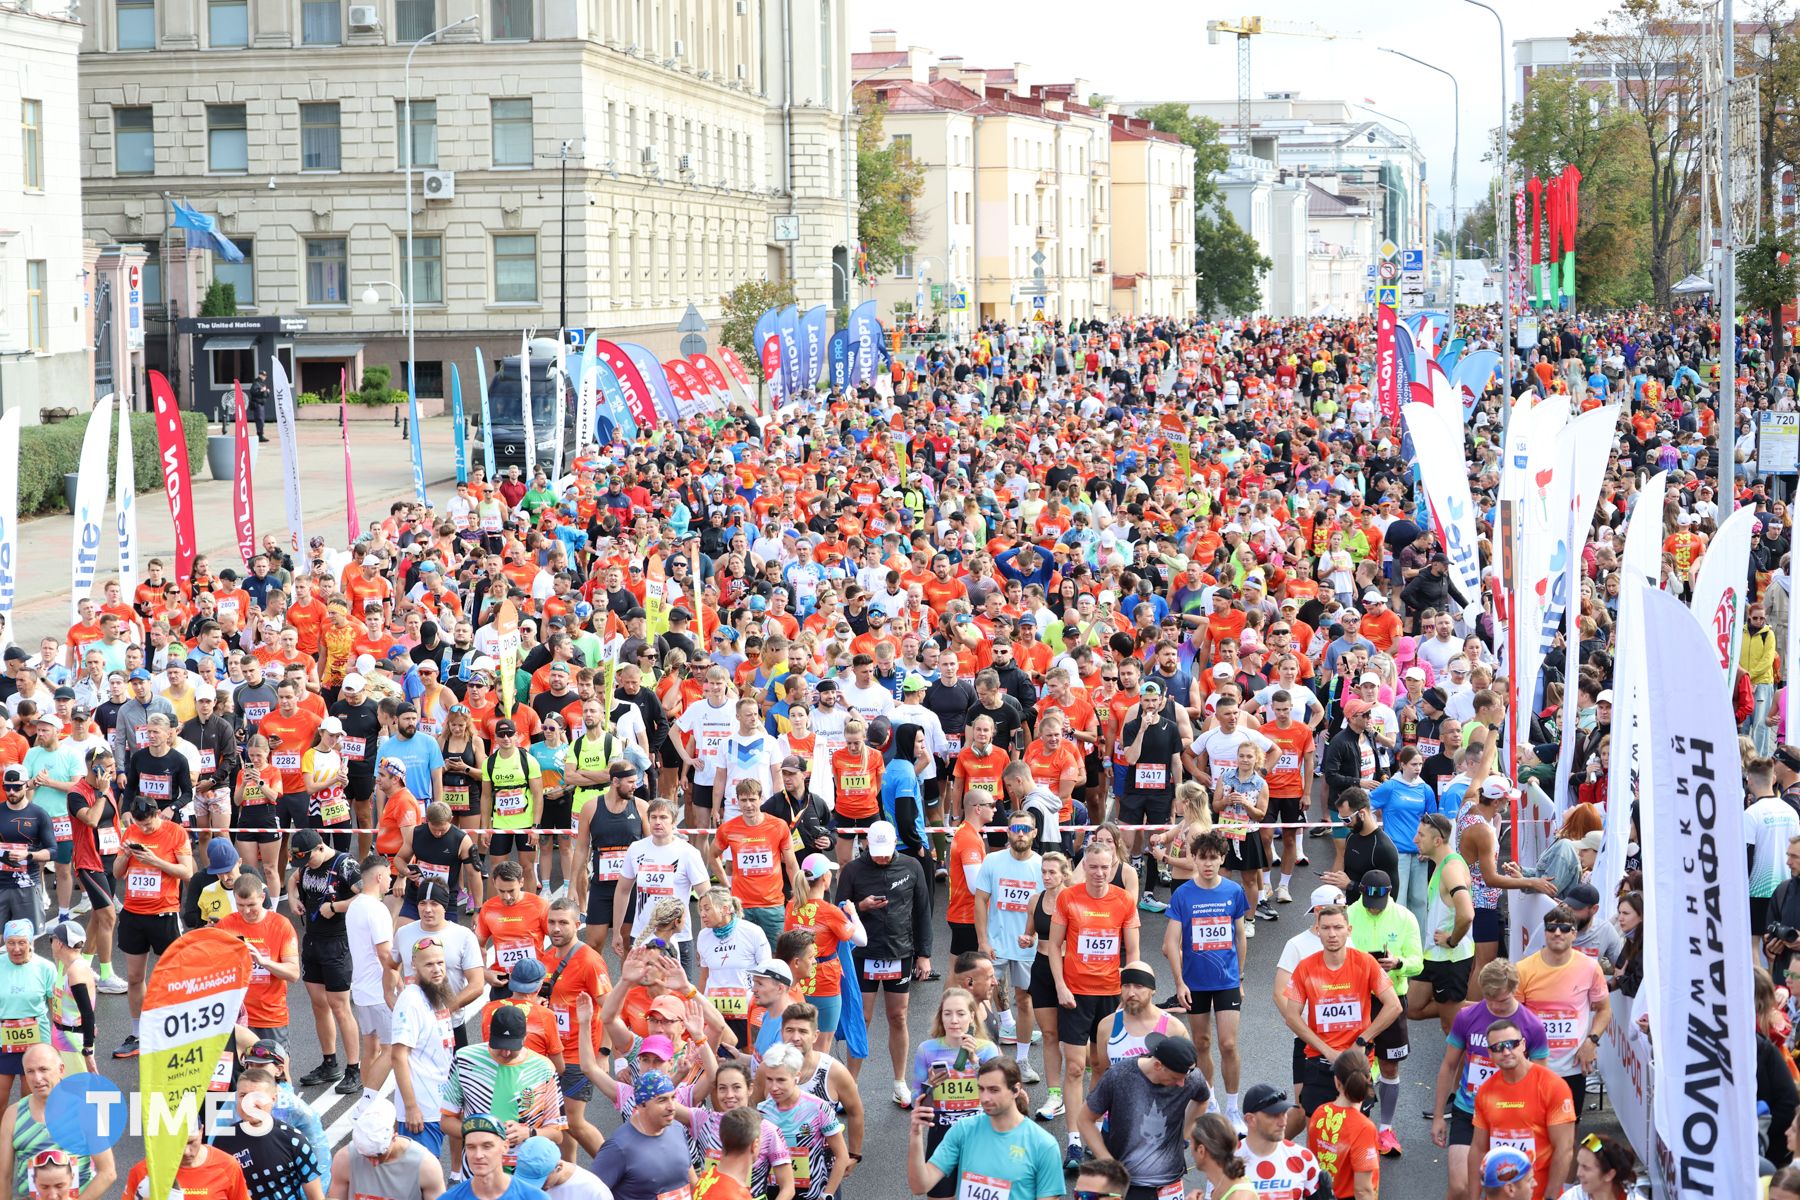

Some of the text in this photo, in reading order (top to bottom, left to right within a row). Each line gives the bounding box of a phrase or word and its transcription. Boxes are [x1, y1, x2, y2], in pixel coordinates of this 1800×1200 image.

[211, 321, 234, 329] United
[1776, 415, 1795, 425] 720
[249, 708, 267, 717] 4259
[343, 742, 361, 752] 1568
[1419, 745, 1436, 754] 2385
[276, 757, 296, 765] 2282
[495, 773, 515, 781] 01:49
[1140, 771, 1162, 779] 3417
[144, 781, 165, 790] 1719
[845, 777, 865, 786] 1171
[445, 793, 464, 802] 3271
[499, 796, 520, 807] 2973
[742, 854, 768, 864] 2915
[132, 876, 156, 887] 2130
[646, 873, 665, 883] 349
[1004, 888, 1030, 900] 1679
[1200, 926, 1227, 938] 1360
[714, 944, 736, 953] CALVI
[1086, 938, 1113, 949] 1657
[503, 949, 529, 962] 2251
[714, 999, 741, 1009] 1114
[1322, 1004, 1353, 1018] 4041
[164, 1003, 225, 1037] 01:39
[6, 1028, 34, 1040] 1065
[167, 1046, 204, 1070] 4:41
[1393, 1050, 1405, 1059] 491
[940, 1081, 974, 1094] 1814
[967, 1184, 999, 1200] 1406
